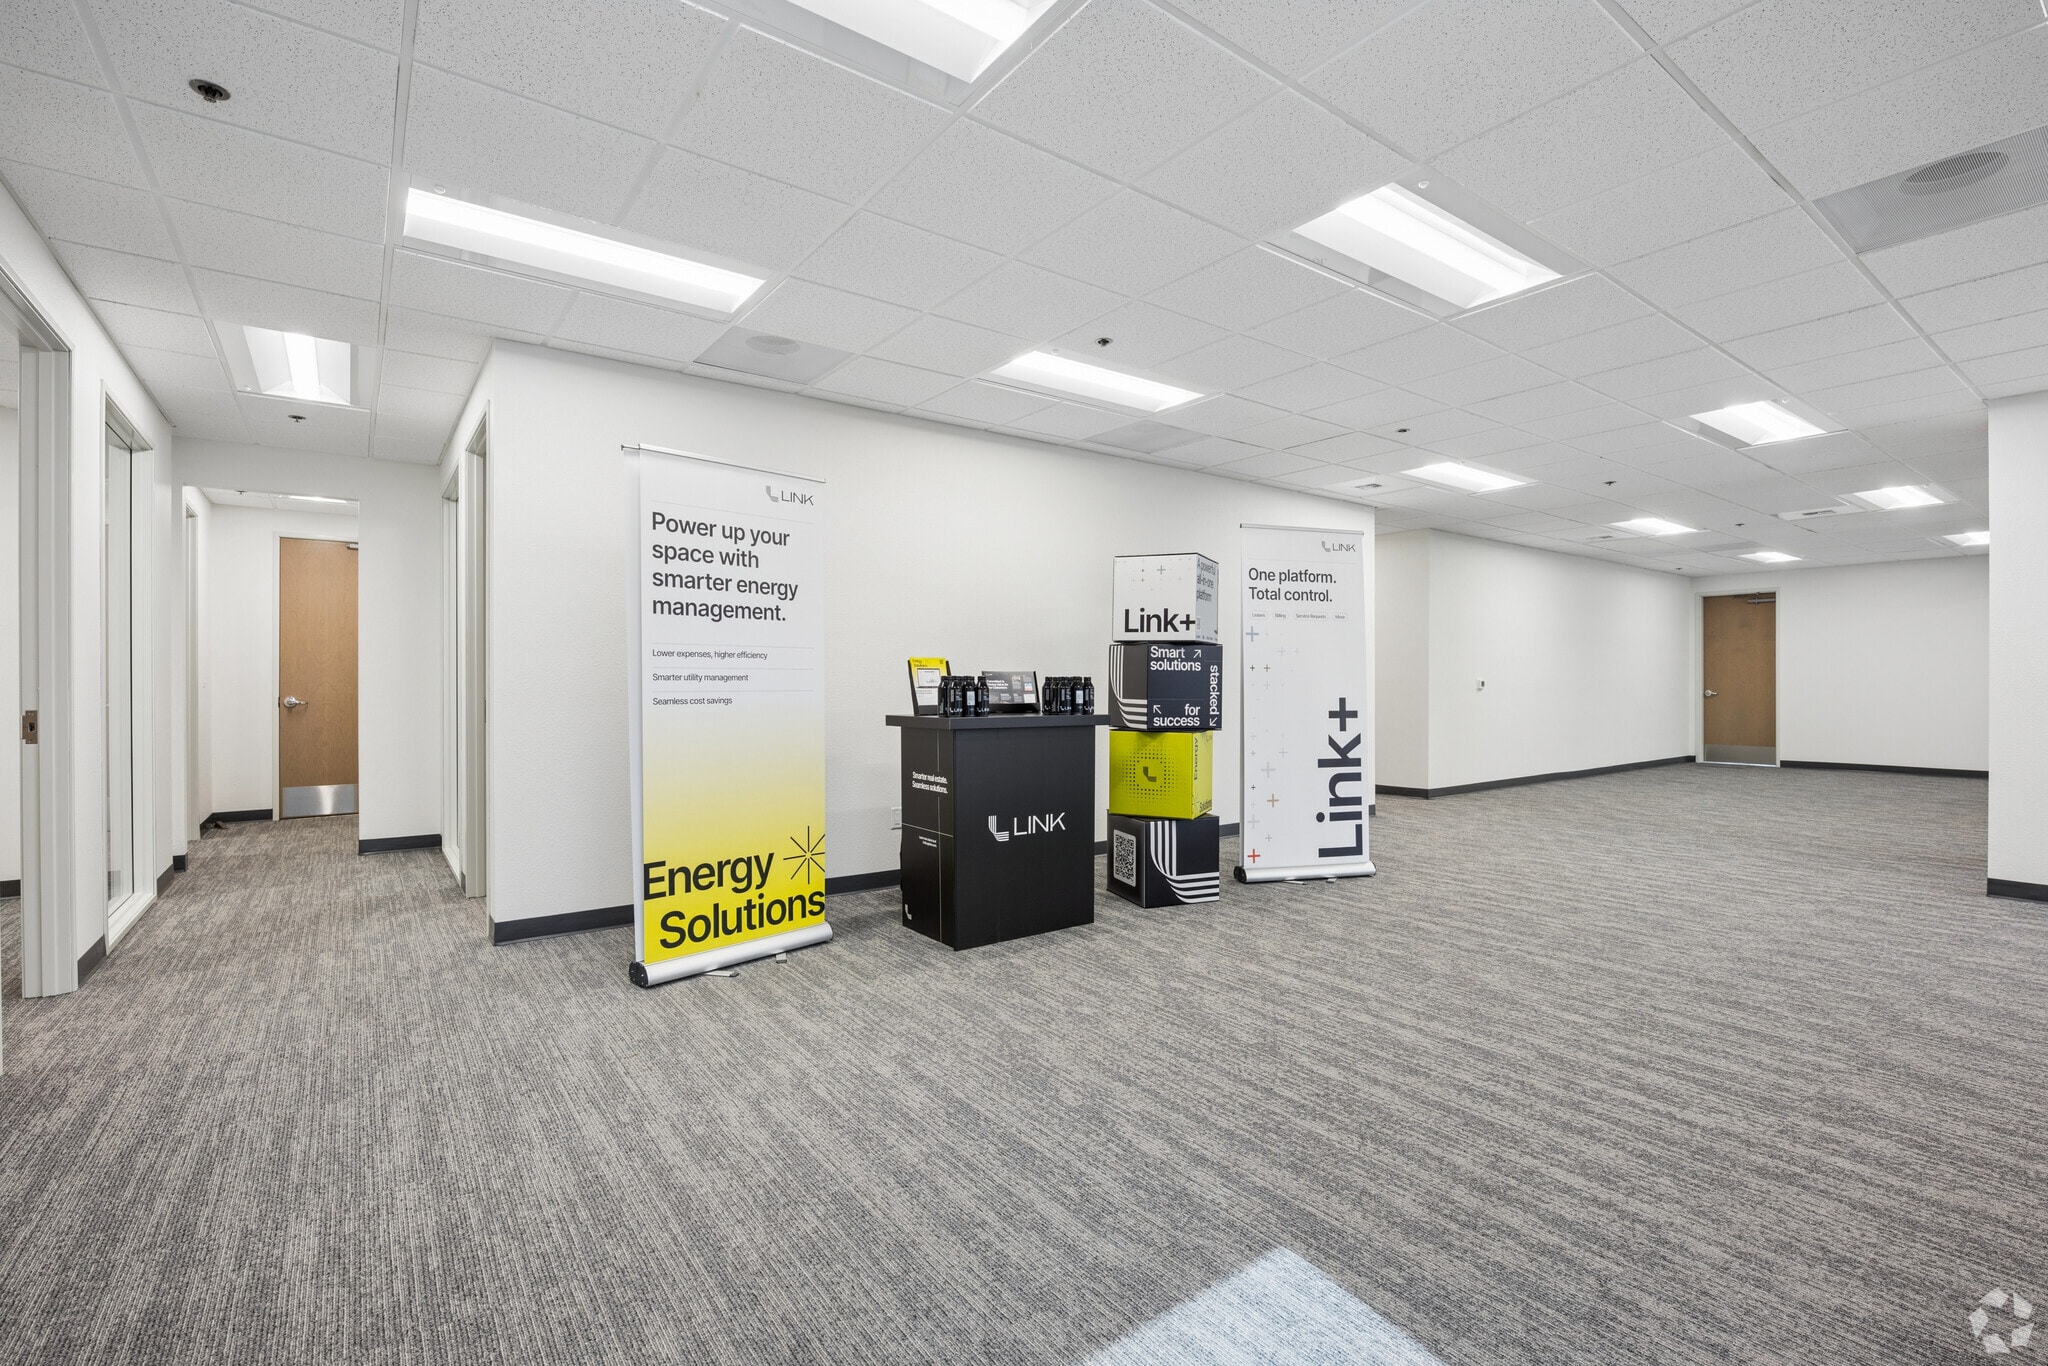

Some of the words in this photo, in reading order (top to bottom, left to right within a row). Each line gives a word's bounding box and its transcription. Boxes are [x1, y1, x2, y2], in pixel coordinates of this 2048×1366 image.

[781, 490, 814, 506] LINK
[652, 511, 717, 537] Power
[722, 525, 745, 544] up
[750, 529, 790, 546] your
[1332, 543, 1356, 552] LINK
[652, 544, 714, 564] space
[719, 549, 759, 568] with
[1248, 568, 1276, 582] One
[1279, 569, 1337, 584] platform.
[652, 572, 732, 592] smarter
[736, 579, 798, 601] energy
[1249, 587, 1281, 601] Total
[1284, 589, 1333, 602] control.
[652, 599, 786, 622] management.
[1124, 607, 1196, 633] Link+
[652, 649, 675, 657] Lower
[676, 650, 713, 659] expenses,
[714, 651, 736, 660] higher
[736, 651, 768, 660] efficiency
[1150, 645, 1185, 659] Smart
[1150, 659, 1201, 671] solutions
[652, 673, 683, 681] Smarter
[683, 673, 703, 683] utility
[704, 674, 749, 683] management
[1209, 665, 1220, 715] stacked
[652, 697, 688, 706] Seamless
[689, 697, 705, 705] cost
[706, 696, 733, 706] savings
[1184, 703, 1200, 716] for
[1153, 716, 1200, 727] success
[912, 771, 927, 780] Smarter
[1316, 697, 1363, 858] Link+
[912, 780, 930, 790] Seamless
[1014, 812, 1066, 836] LINK
[643, 852, 775, 900] Energy
[659, 891, 825, 949] Solutions
